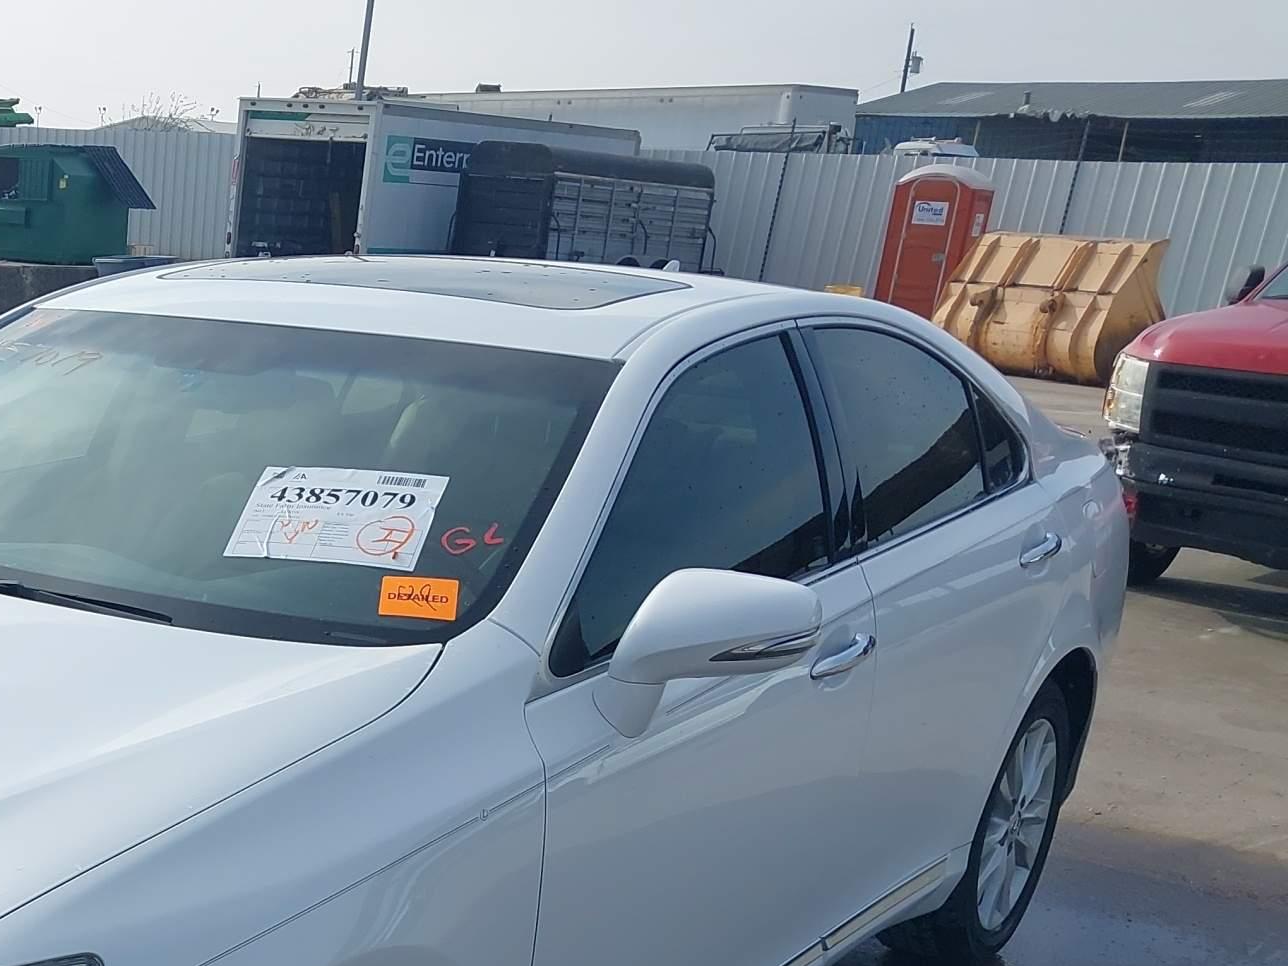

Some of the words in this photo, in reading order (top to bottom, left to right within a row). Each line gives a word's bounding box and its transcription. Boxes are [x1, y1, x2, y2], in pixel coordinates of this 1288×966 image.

[918, 205, 944, 213] United
[270, 486, 416, 510] 43857079
[388, 592, 449, 604] DETAILED
